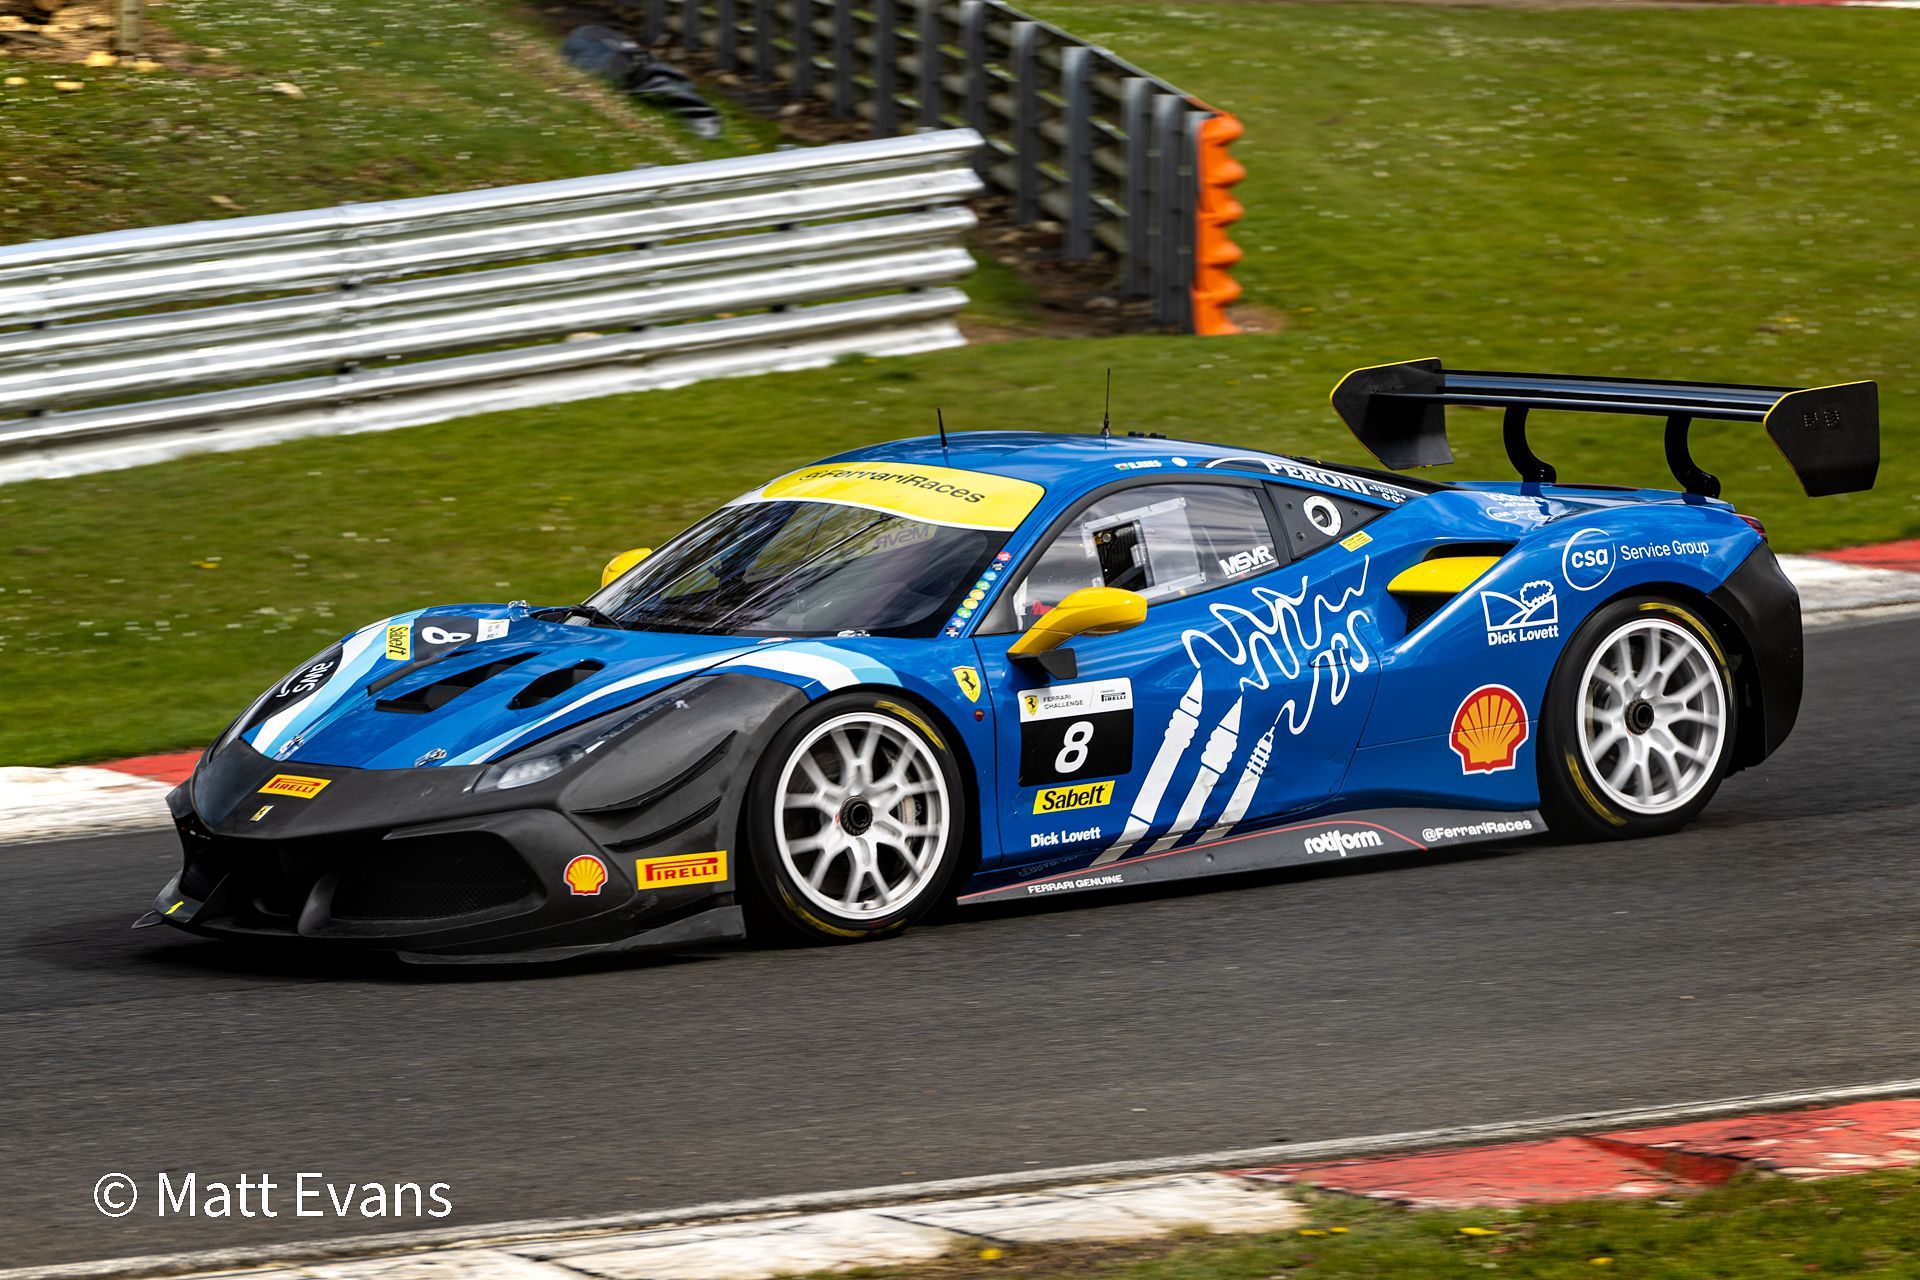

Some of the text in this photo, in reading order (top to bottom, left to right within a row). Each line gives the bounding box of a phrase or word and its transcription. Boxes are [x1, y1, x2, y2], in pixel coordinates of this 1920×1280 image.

[1261, 460, 1371, 496] PERONI
[1219, 546, 1274, 576] MSVR
[1571, 540, 1710, 569] csa Service Group
[421, 626, 473, 645] 8
[1487, 625, 1559, 646] Dick Lovett
[1042, 694, 1072, 702] FERRARI
[1044, 699, 1084, 710] CHALLENGE
[1054, 720, 1094, 774] 8
[267, 778, 321, 793] PIRELLI
[1042, 784, 1106, 811] Sabelt
[1030, 826, 1101, 848] Dick Lovett
[1303, 829, 1383, 857] rotiform
[1422, 818, 1533, 843] @FerrariRaces
[645, 856, 719, 882] PIRELLI
[1027, 874, 1124, 895] FERRARI GENUINE
